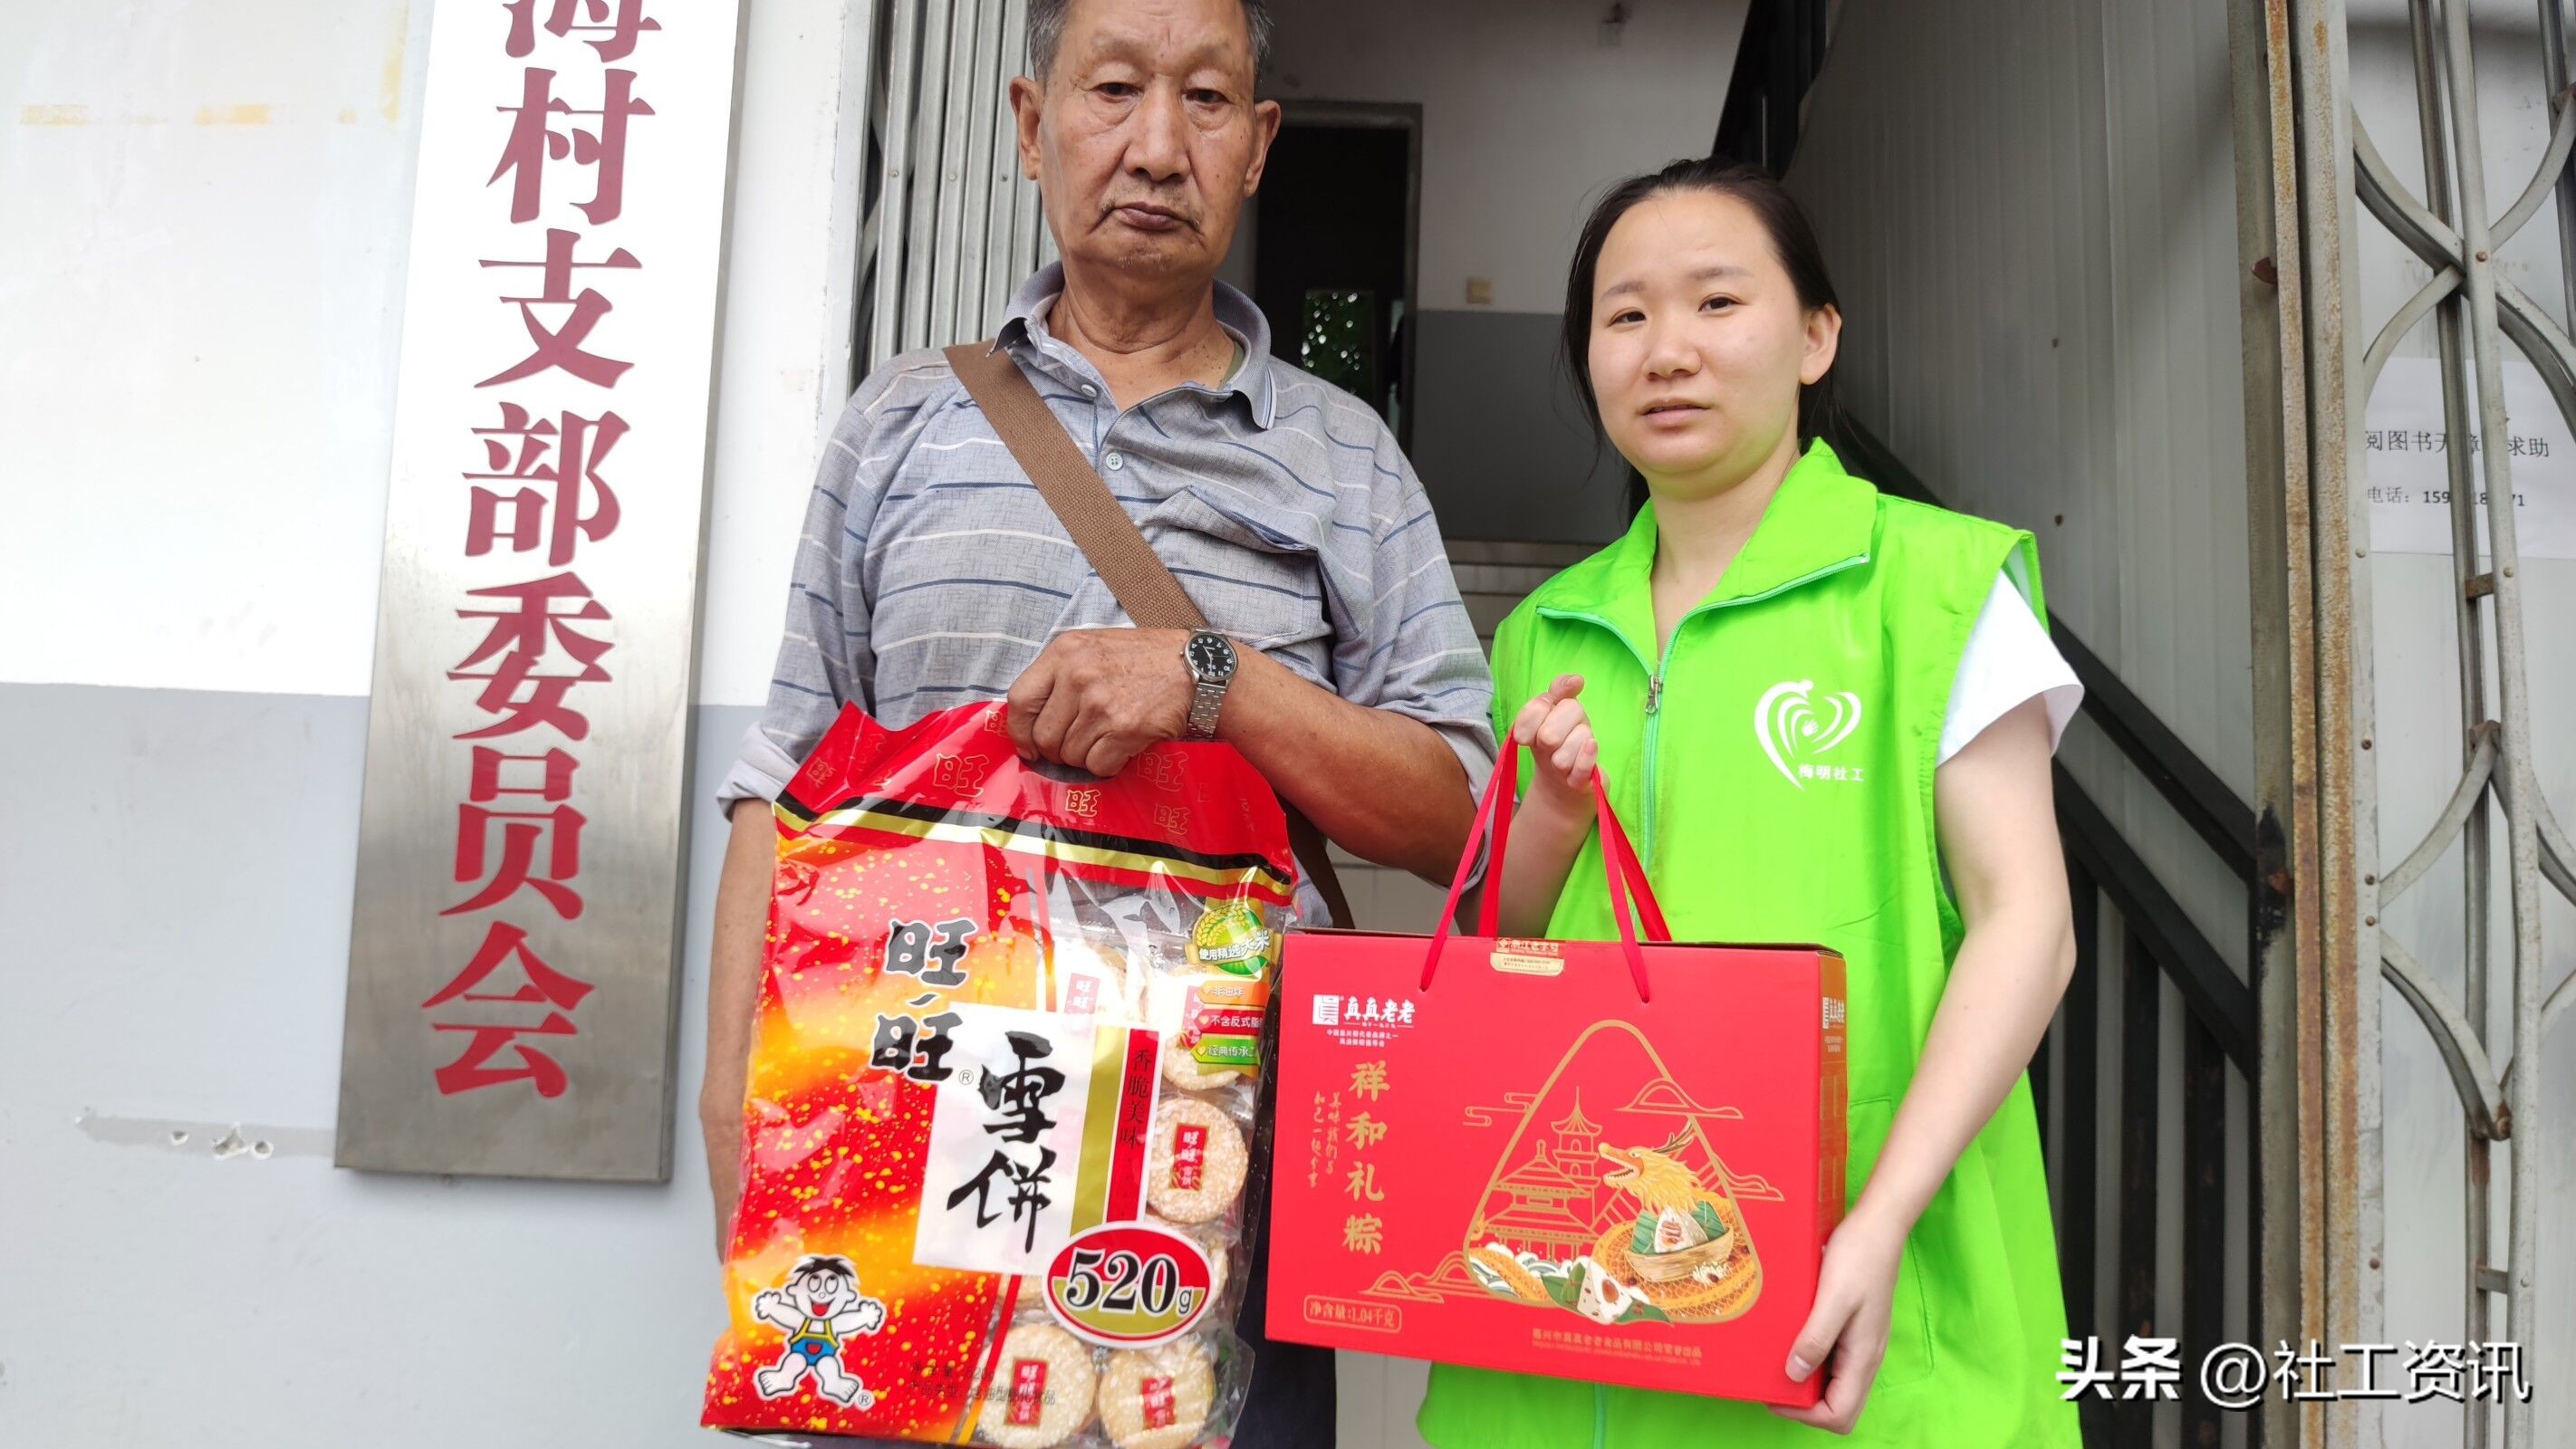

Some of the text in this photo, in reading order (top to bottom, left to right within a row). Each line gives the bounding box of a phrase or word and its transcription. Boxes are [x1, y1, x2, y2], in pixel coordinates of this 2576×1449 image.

[932, 753, 990, 797] 旺
[1065, 790, 1101, 817] 旺
[1198, 930, 1271, 961] 使用精选大米
[870, 920, 977, 1082] 旺旺
[1343, 995, 1416, 1024] 真真老老
[1120, 1049, 1151, 1149] 香脆美味
[947, 1031, 1066, 1254] 雪饼
[1342, 1060, 1390, 1255] 祥和礼粽
[1065, 1249, 1193, 1316] 520g
